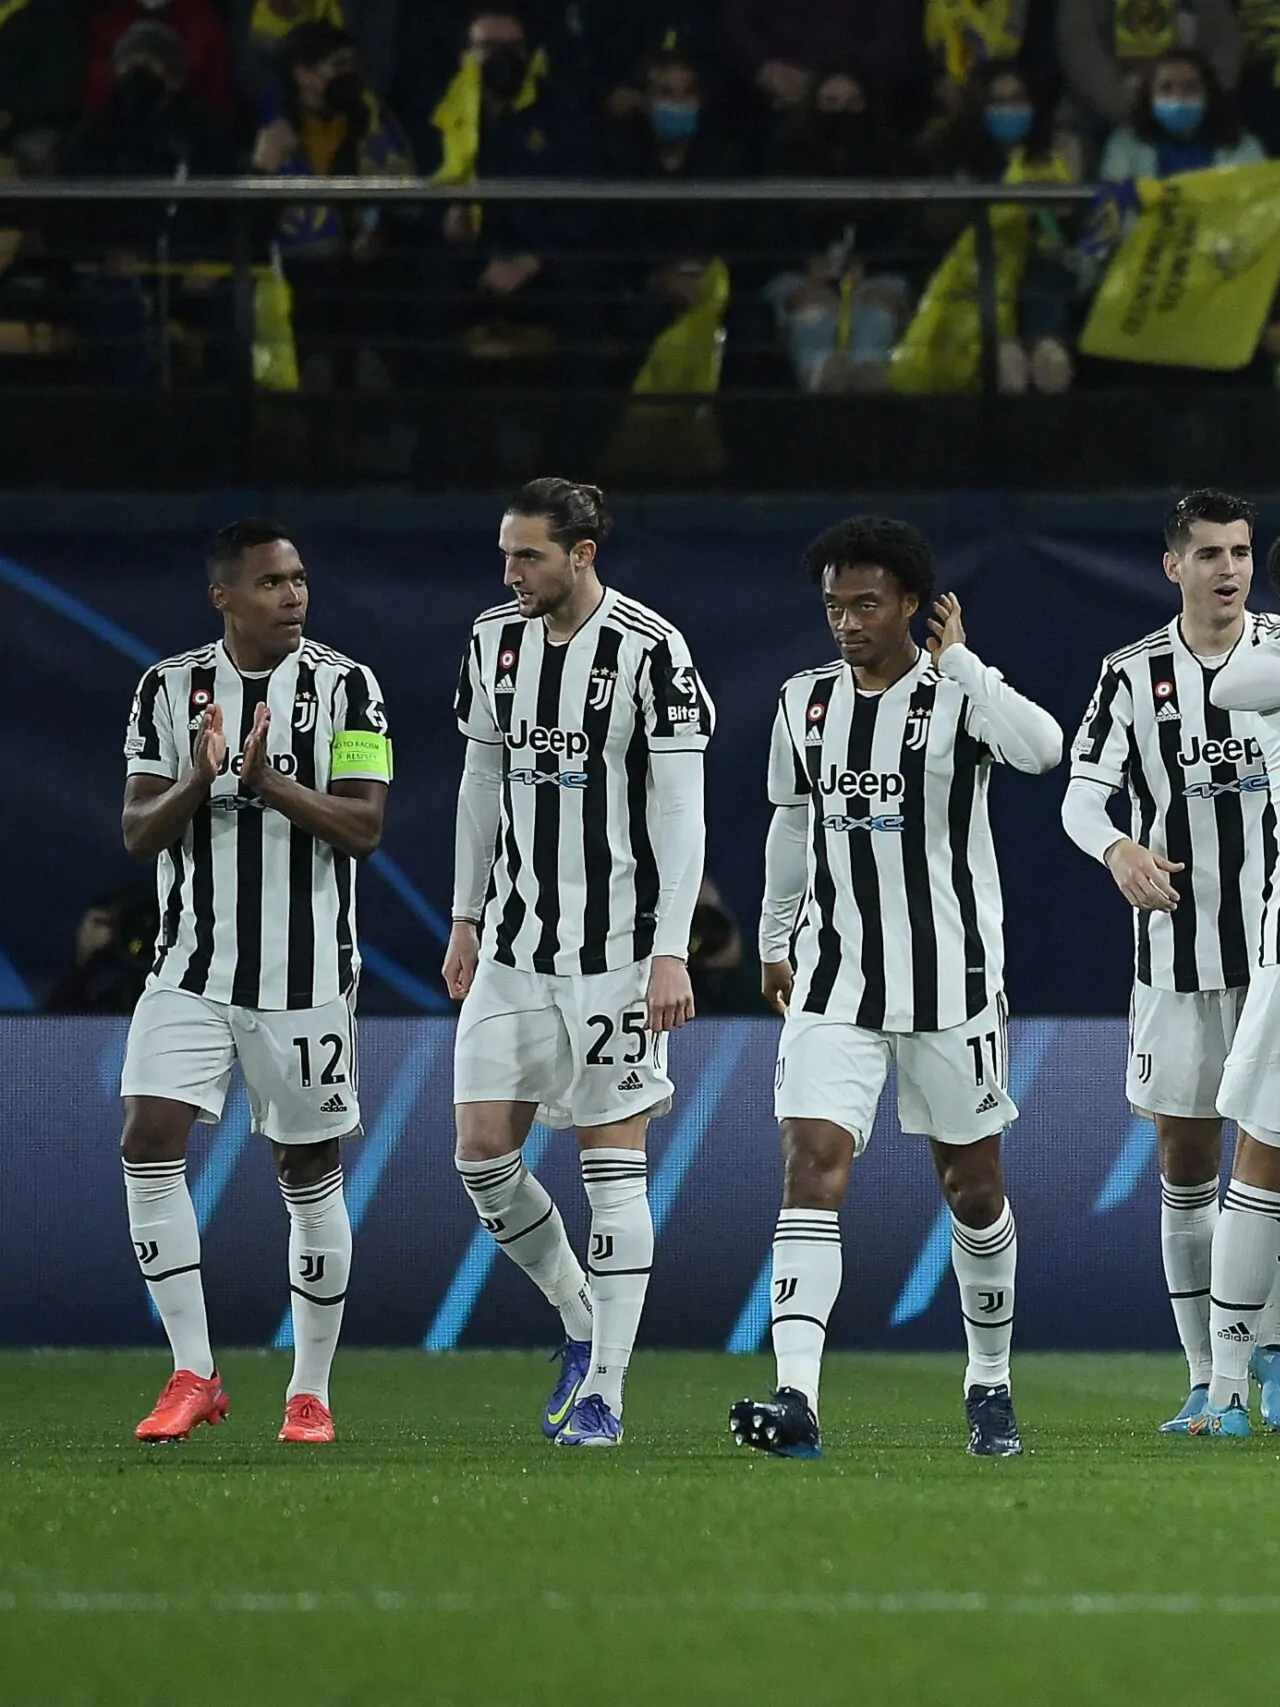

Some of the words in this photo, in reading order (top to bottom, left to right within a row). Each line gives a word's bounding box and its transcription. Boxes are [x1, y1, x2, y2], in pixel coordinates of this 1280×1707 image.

[667, 705, 699, 722] Bitg
[1155, 712, 1182, 722] adidas
[506, 719, 588, 760] Jeep
[1178, 736, 1264, 766] Jeep
[217, 746, 296, 776] Jep
[820, 764, 903, 803] Jeep
[586, 1011, 647, 1065] 25
[293, 1033, 346, 1088] 12
[966, 1031, 998, 1087] 11
